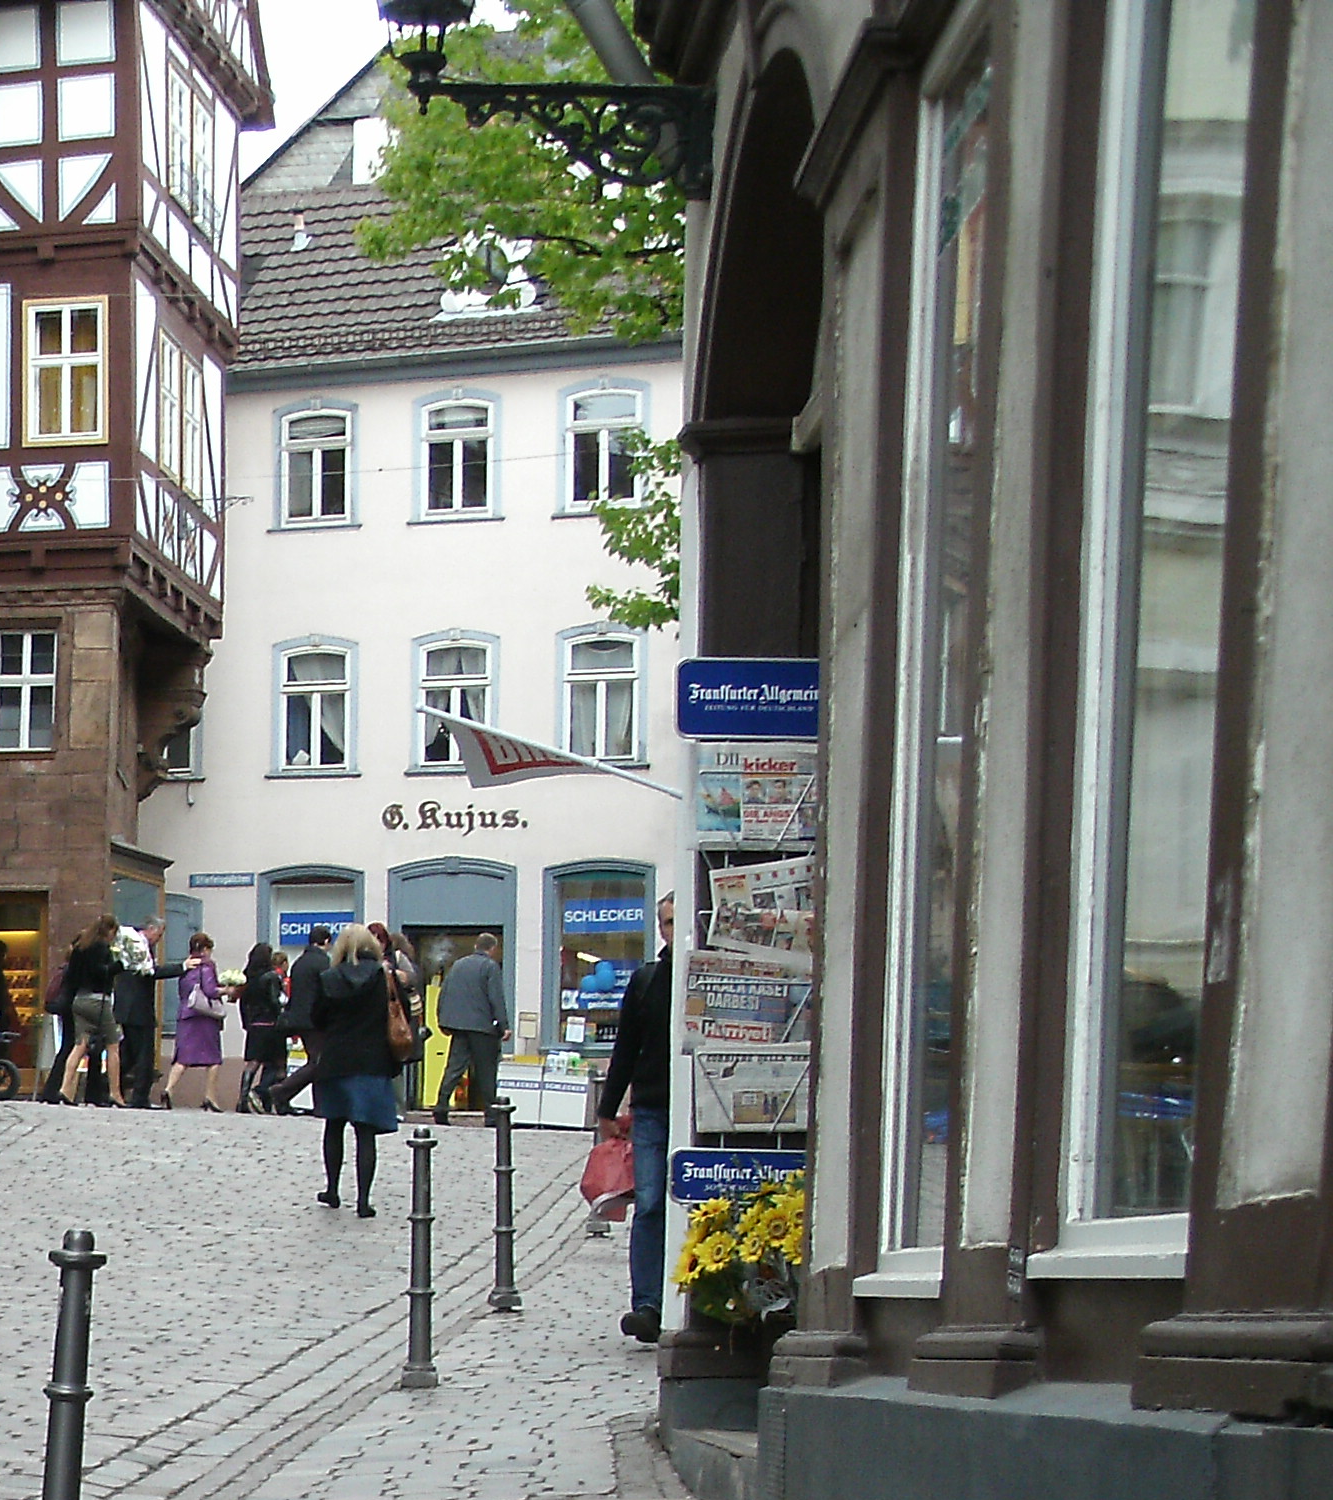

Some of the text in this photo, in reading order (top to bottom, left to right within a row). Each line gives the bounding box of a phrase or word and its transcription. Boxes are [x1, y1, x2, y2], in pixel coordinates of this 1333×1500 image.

[688, 683, 819, 705] Frankfurter Allgemein
[743, 757, 797, 771] kicker
[564, 908, 644, 923] SCHLECKER
[281, 922, 351, 935] SCHLKE
